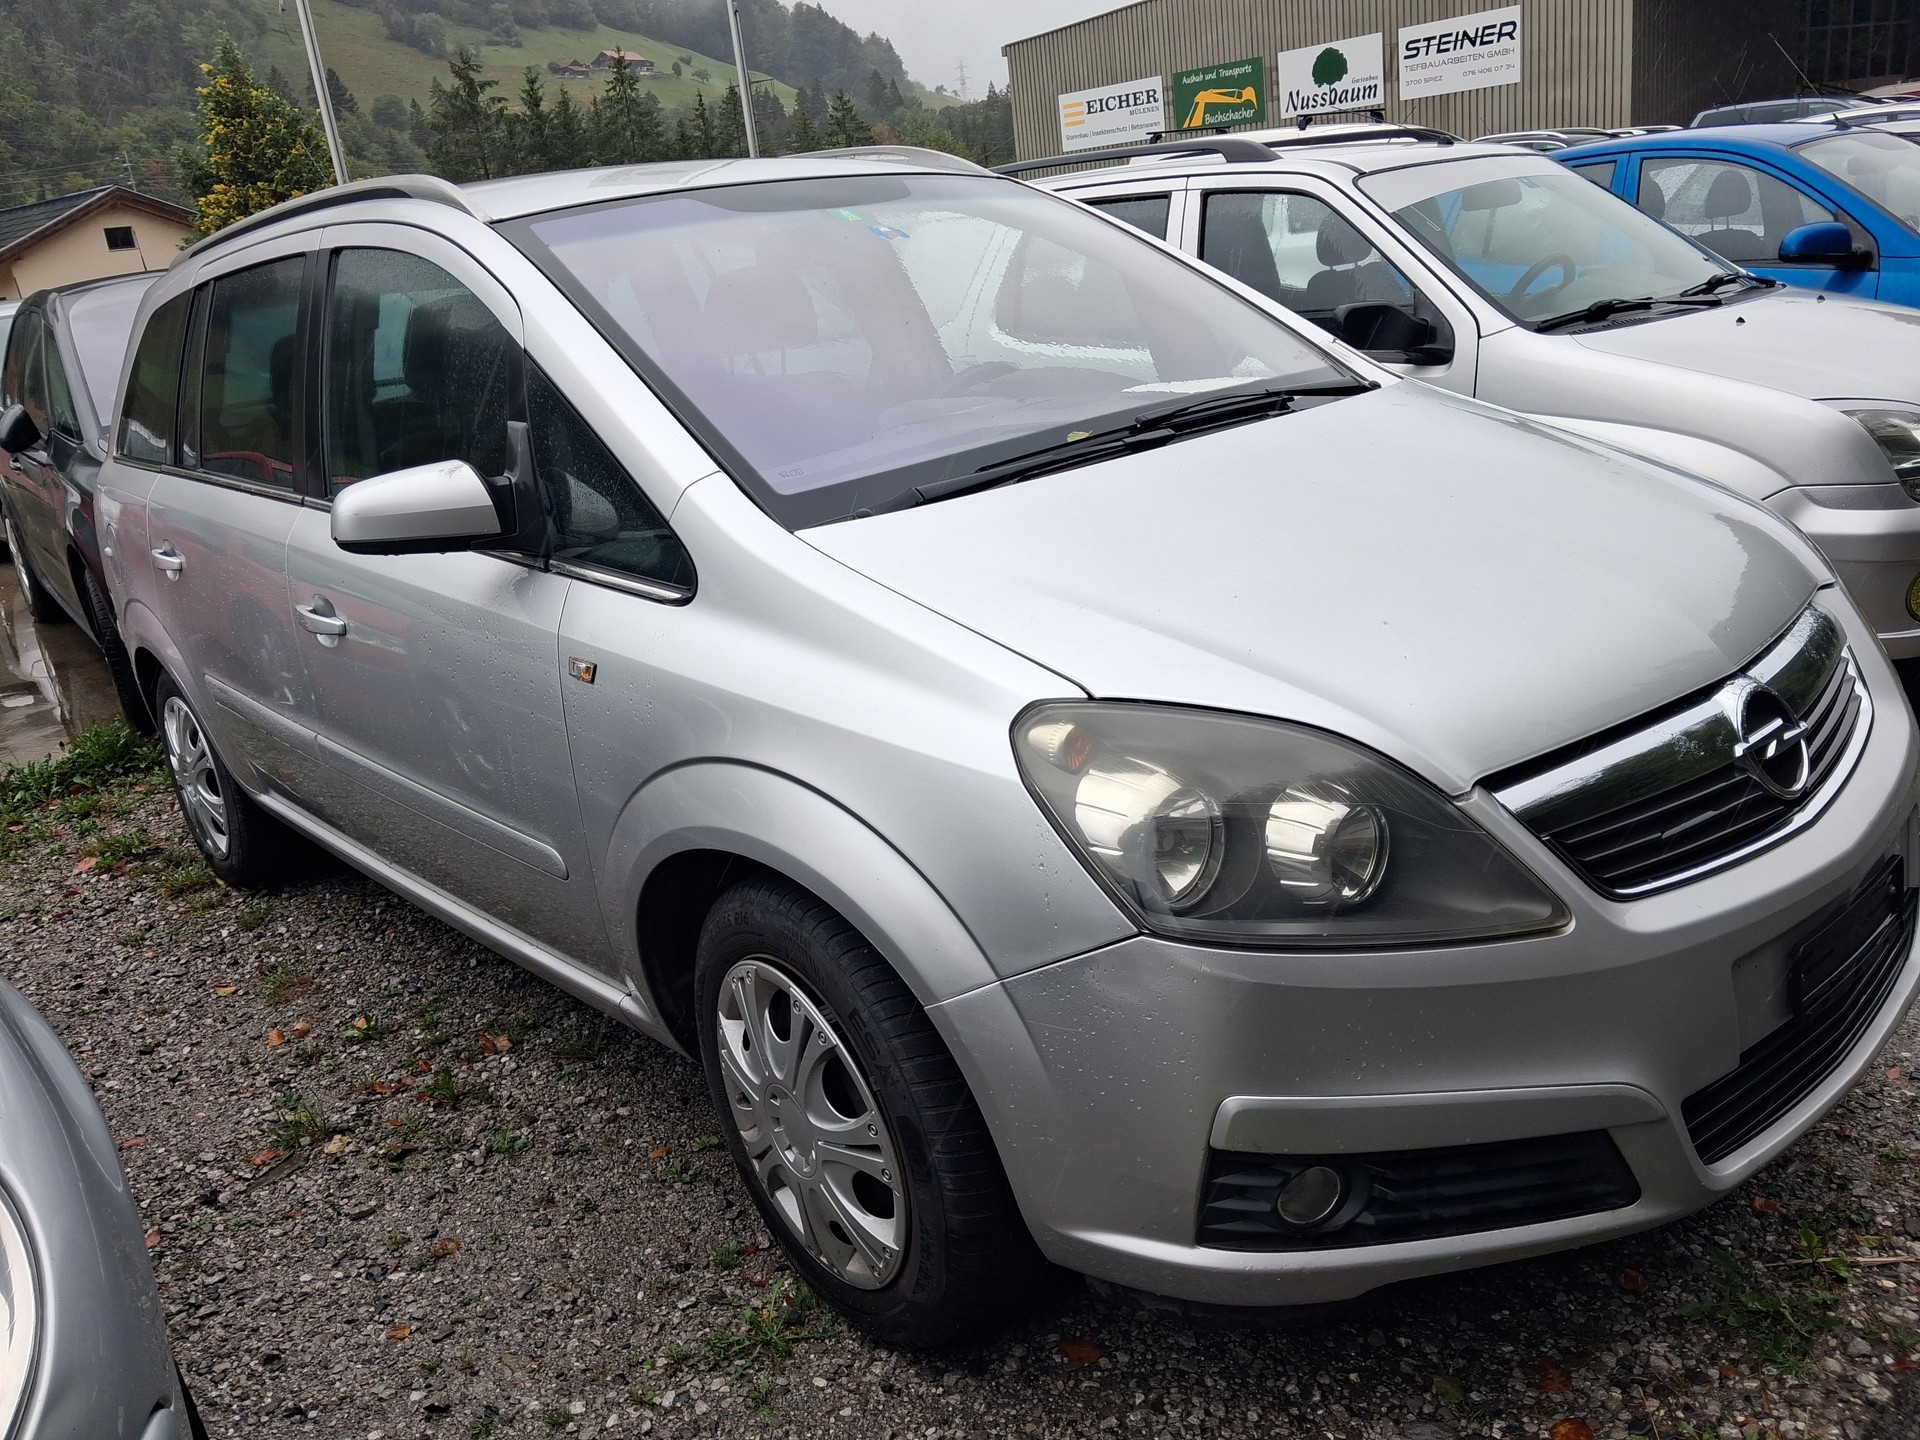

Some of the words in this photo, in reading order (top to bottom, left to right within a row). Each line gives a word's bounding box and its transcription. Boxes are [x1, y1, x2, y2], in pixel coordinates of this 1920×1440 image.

[1403, 20, 1517, 60] STEINER
[1404, 52, 1485, 72] TIEFBAUARBEITEN
[1486, 47, 1515, 59] GMBH
[1182, 71, 1204, 85] Aushub
[1205, 69, 1217, 80] und
[1218, 64, 1252, 78] Transporte
[1405, 78, 1422, 87] 3700
[1423, 75, 1443, 84] SPIEZ
[1085, 88, 1160, 115] EICHER
[1285, 83, 1378, 113] Nussbaum
[1129, 105, 1160, 116] MÜLENEN
[1204, 106, 1255, 125] Buchschacher
